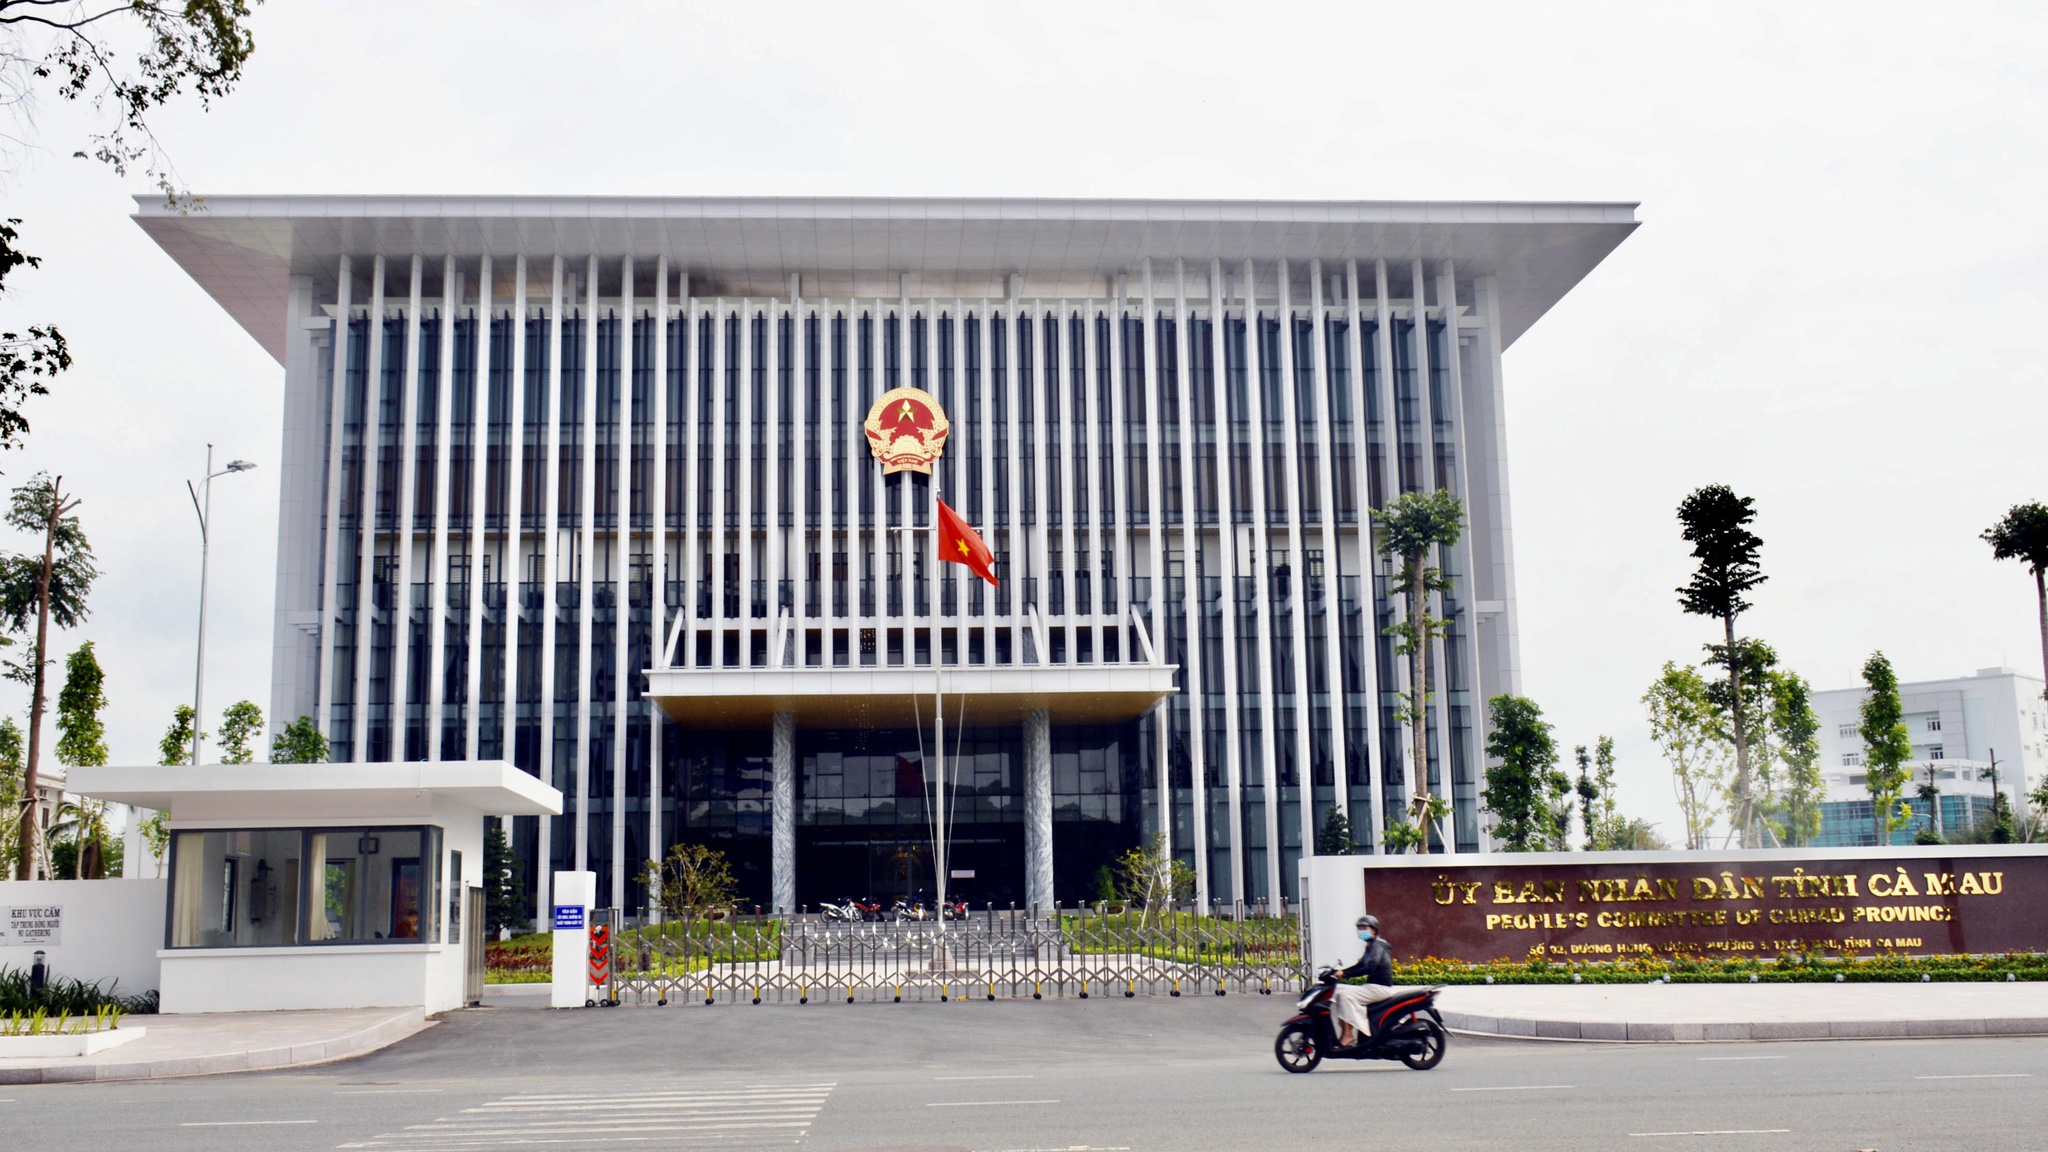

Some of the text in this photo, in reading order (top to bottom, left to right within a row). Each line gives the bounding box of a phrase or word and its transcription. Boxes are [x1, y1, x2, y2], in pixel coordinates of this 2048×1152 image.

[1431, 867, 2004, 904] ỦY BAN NHÂN DÂN TỈNH CÀ MAU
[11, 909, 27, 918] KHU
[44, 906, 61, 918] CẤM
[1486, 912, 1589, 931] PEOPLE'S
[1597, 910, 1728, 929] COMMITTEE
[1736, 909, 1762, 925] OF
[1529, 942, 1545, 955] SỐ
[1895, 937, 1923, 948] MAU
